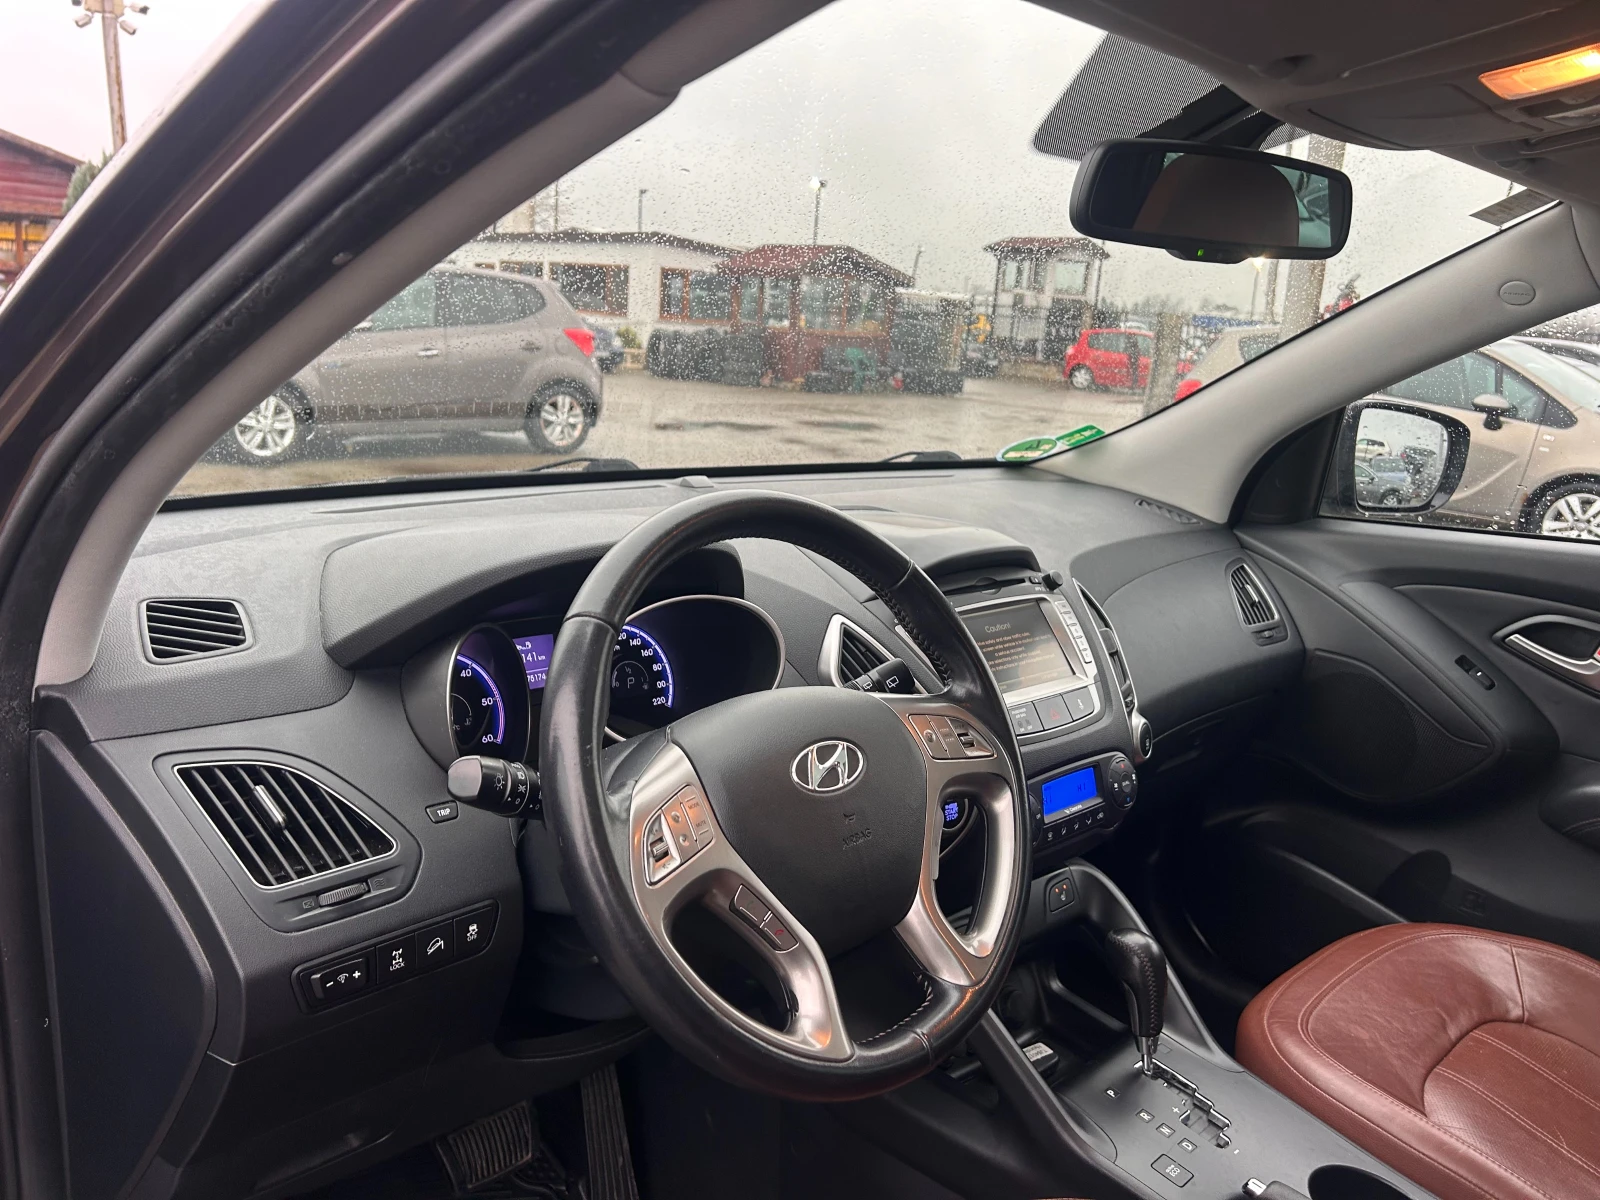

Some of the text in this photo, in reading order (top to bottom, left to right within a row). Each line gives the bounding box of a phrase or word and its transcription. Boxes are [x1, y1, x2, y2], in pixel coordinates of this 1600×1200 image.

[984, 622, 1012, 633] Caution!
[618, 632, 627, 640] 20
[629, 638, 641, 646] 140
[640, 649, 653, 658] 160
[460, 669, 472, 678] 40
[627, 676, 634, 689] P
[482, 697, 493, 706] 50
[652, 696, 666, 706] 220
[482, 734, 494, 743] 60
[436, 807, 452, 816] TRIP
[467, 934, 478, 942] OFF
[390, 962, 405, 972] LOCK
[1106, 1089, 1116, 1098] P
[1140, 1112, 1151, 1121] R
[1160, 1126, 1171, 1136] N
[1182, 1140, 1192, 1150] D
